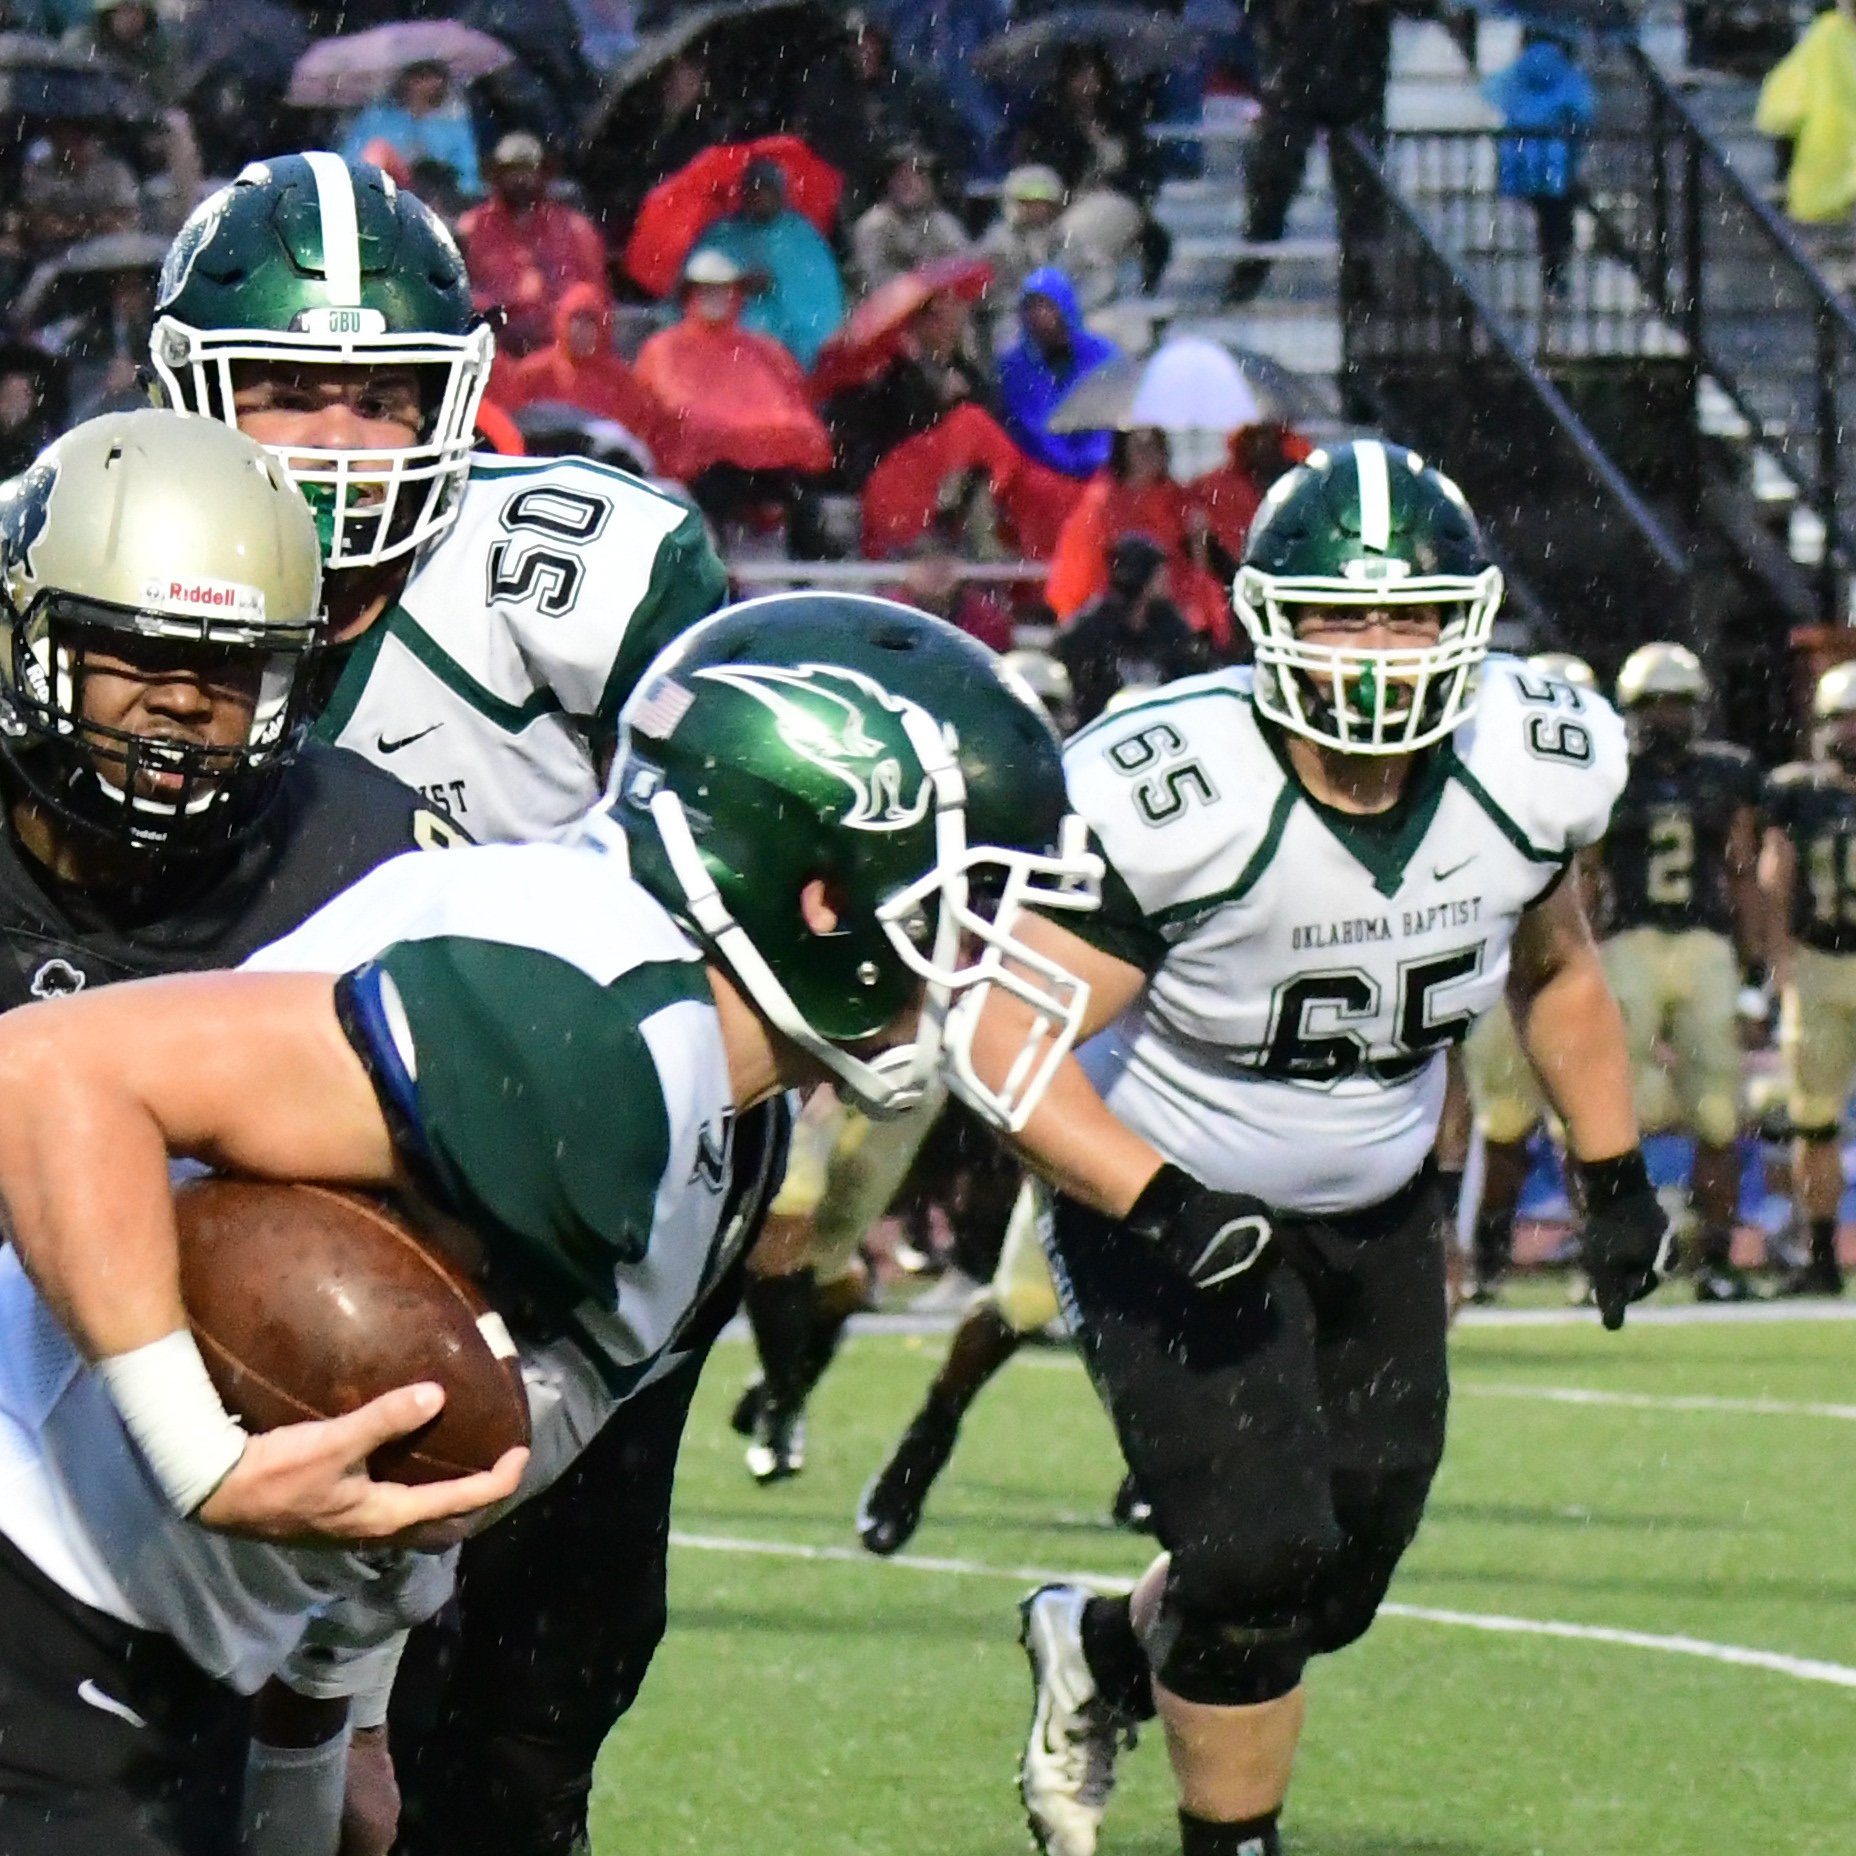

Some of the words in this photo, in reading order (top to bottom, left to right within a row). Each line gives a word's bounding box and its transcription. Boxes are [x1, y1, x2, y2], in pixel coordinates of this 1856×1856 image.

[328, 311, 361, 334] OBU
[169, 582, 235, 607] Riddell
[486, 484, 614, 618] 50
[1505, 671, 1596, 770] 65
[1101, 720, 1222, 830] 65
[1646, 817, 1695, 904] 2
[1291, 916, 1393, 950] OKLAHOMA
[1402, 896, 1482, 937] BAPTIST
[1260, 938, 1488, 1097] 65
